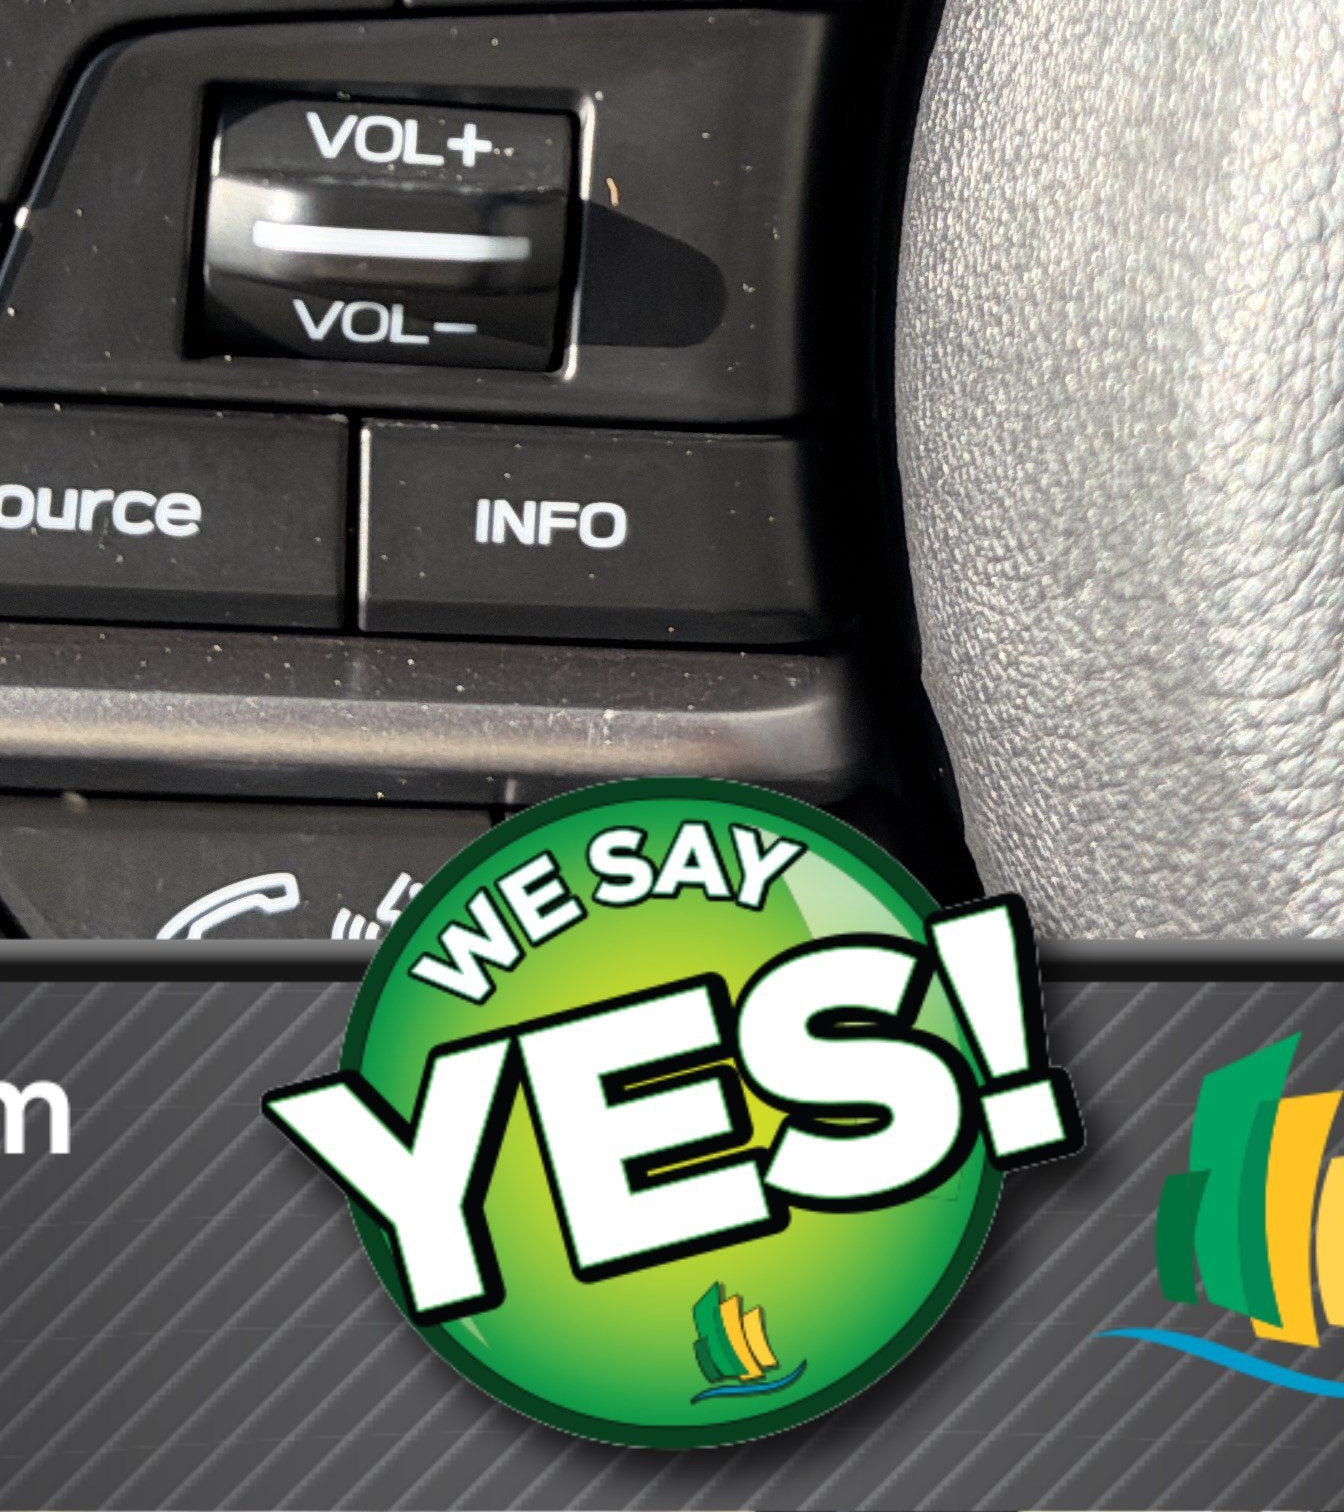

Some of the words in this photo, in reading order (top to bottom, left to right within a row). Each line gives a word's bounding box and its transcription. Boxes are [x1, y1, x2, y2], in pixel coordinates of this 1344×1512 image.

[306, 111, 492, 169] VOL+
[292, 298, 478, 345] VOL-
[475, 498, 628, 549] INFO
